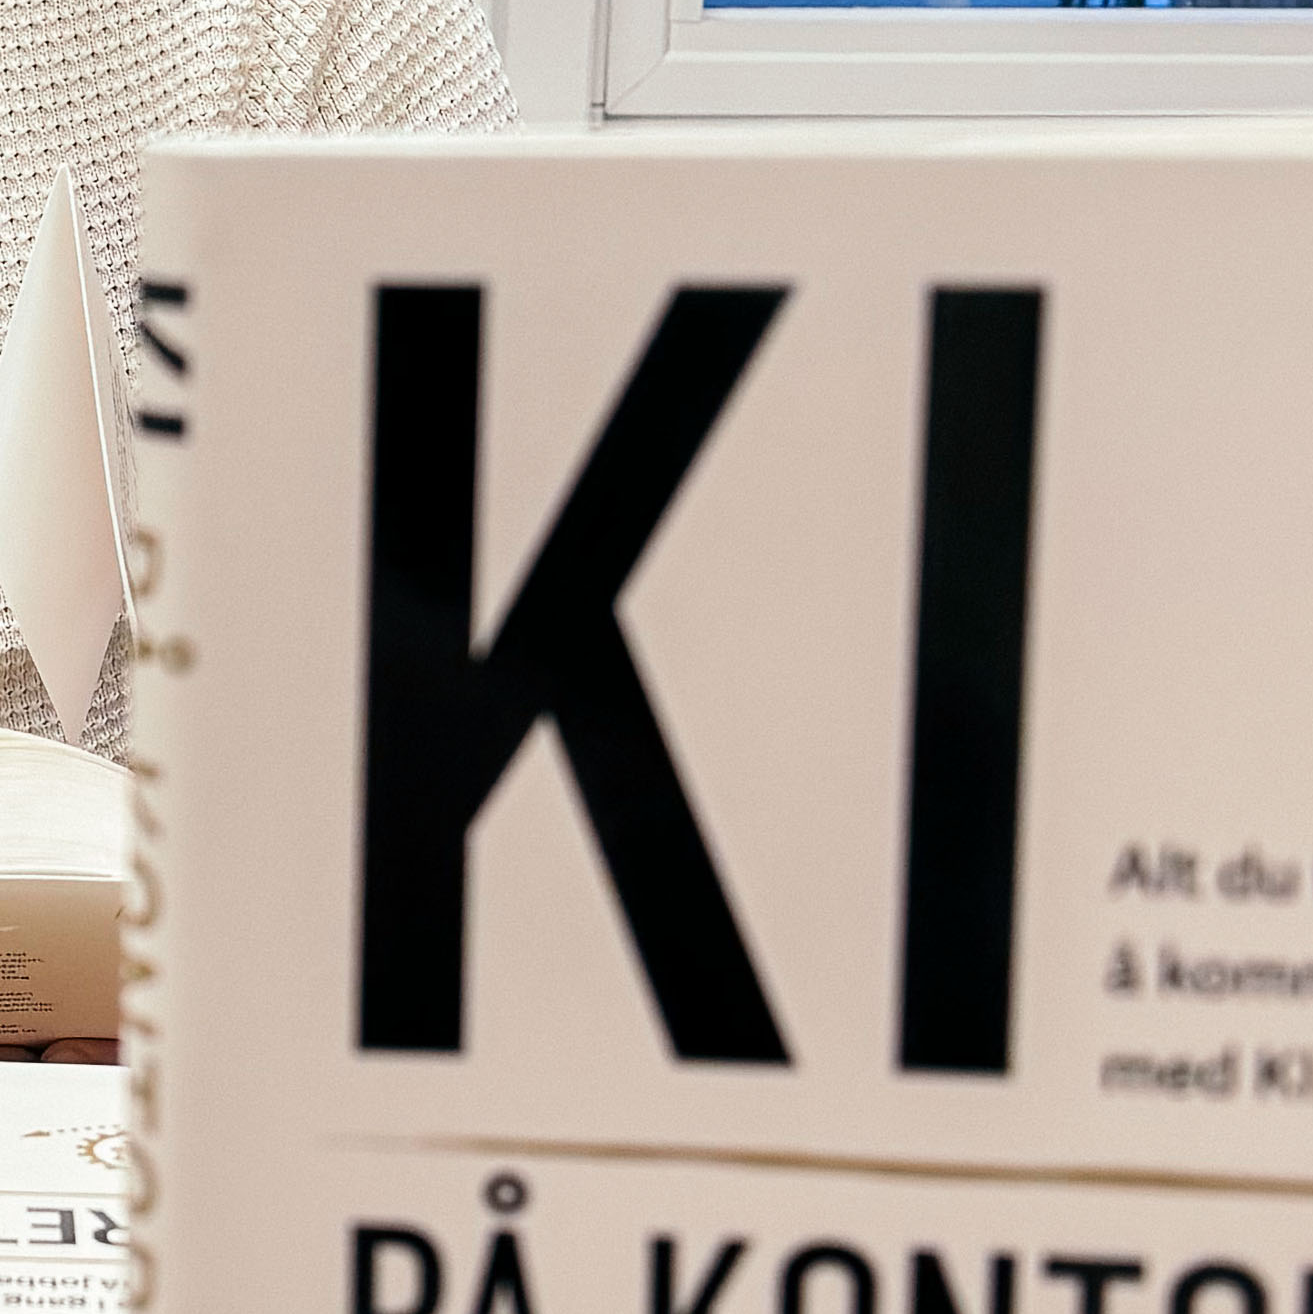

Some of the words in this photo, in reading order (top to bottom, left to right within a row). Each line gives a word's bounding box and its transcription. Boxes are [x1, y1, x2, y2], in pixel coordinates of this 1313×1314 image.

[353, 279, 1049, 1080] KI
[1107, 841, 1199, 900] Alt
[1216, 844, 1301, 903] du
[1100, 1044, 1240, 1101] med
